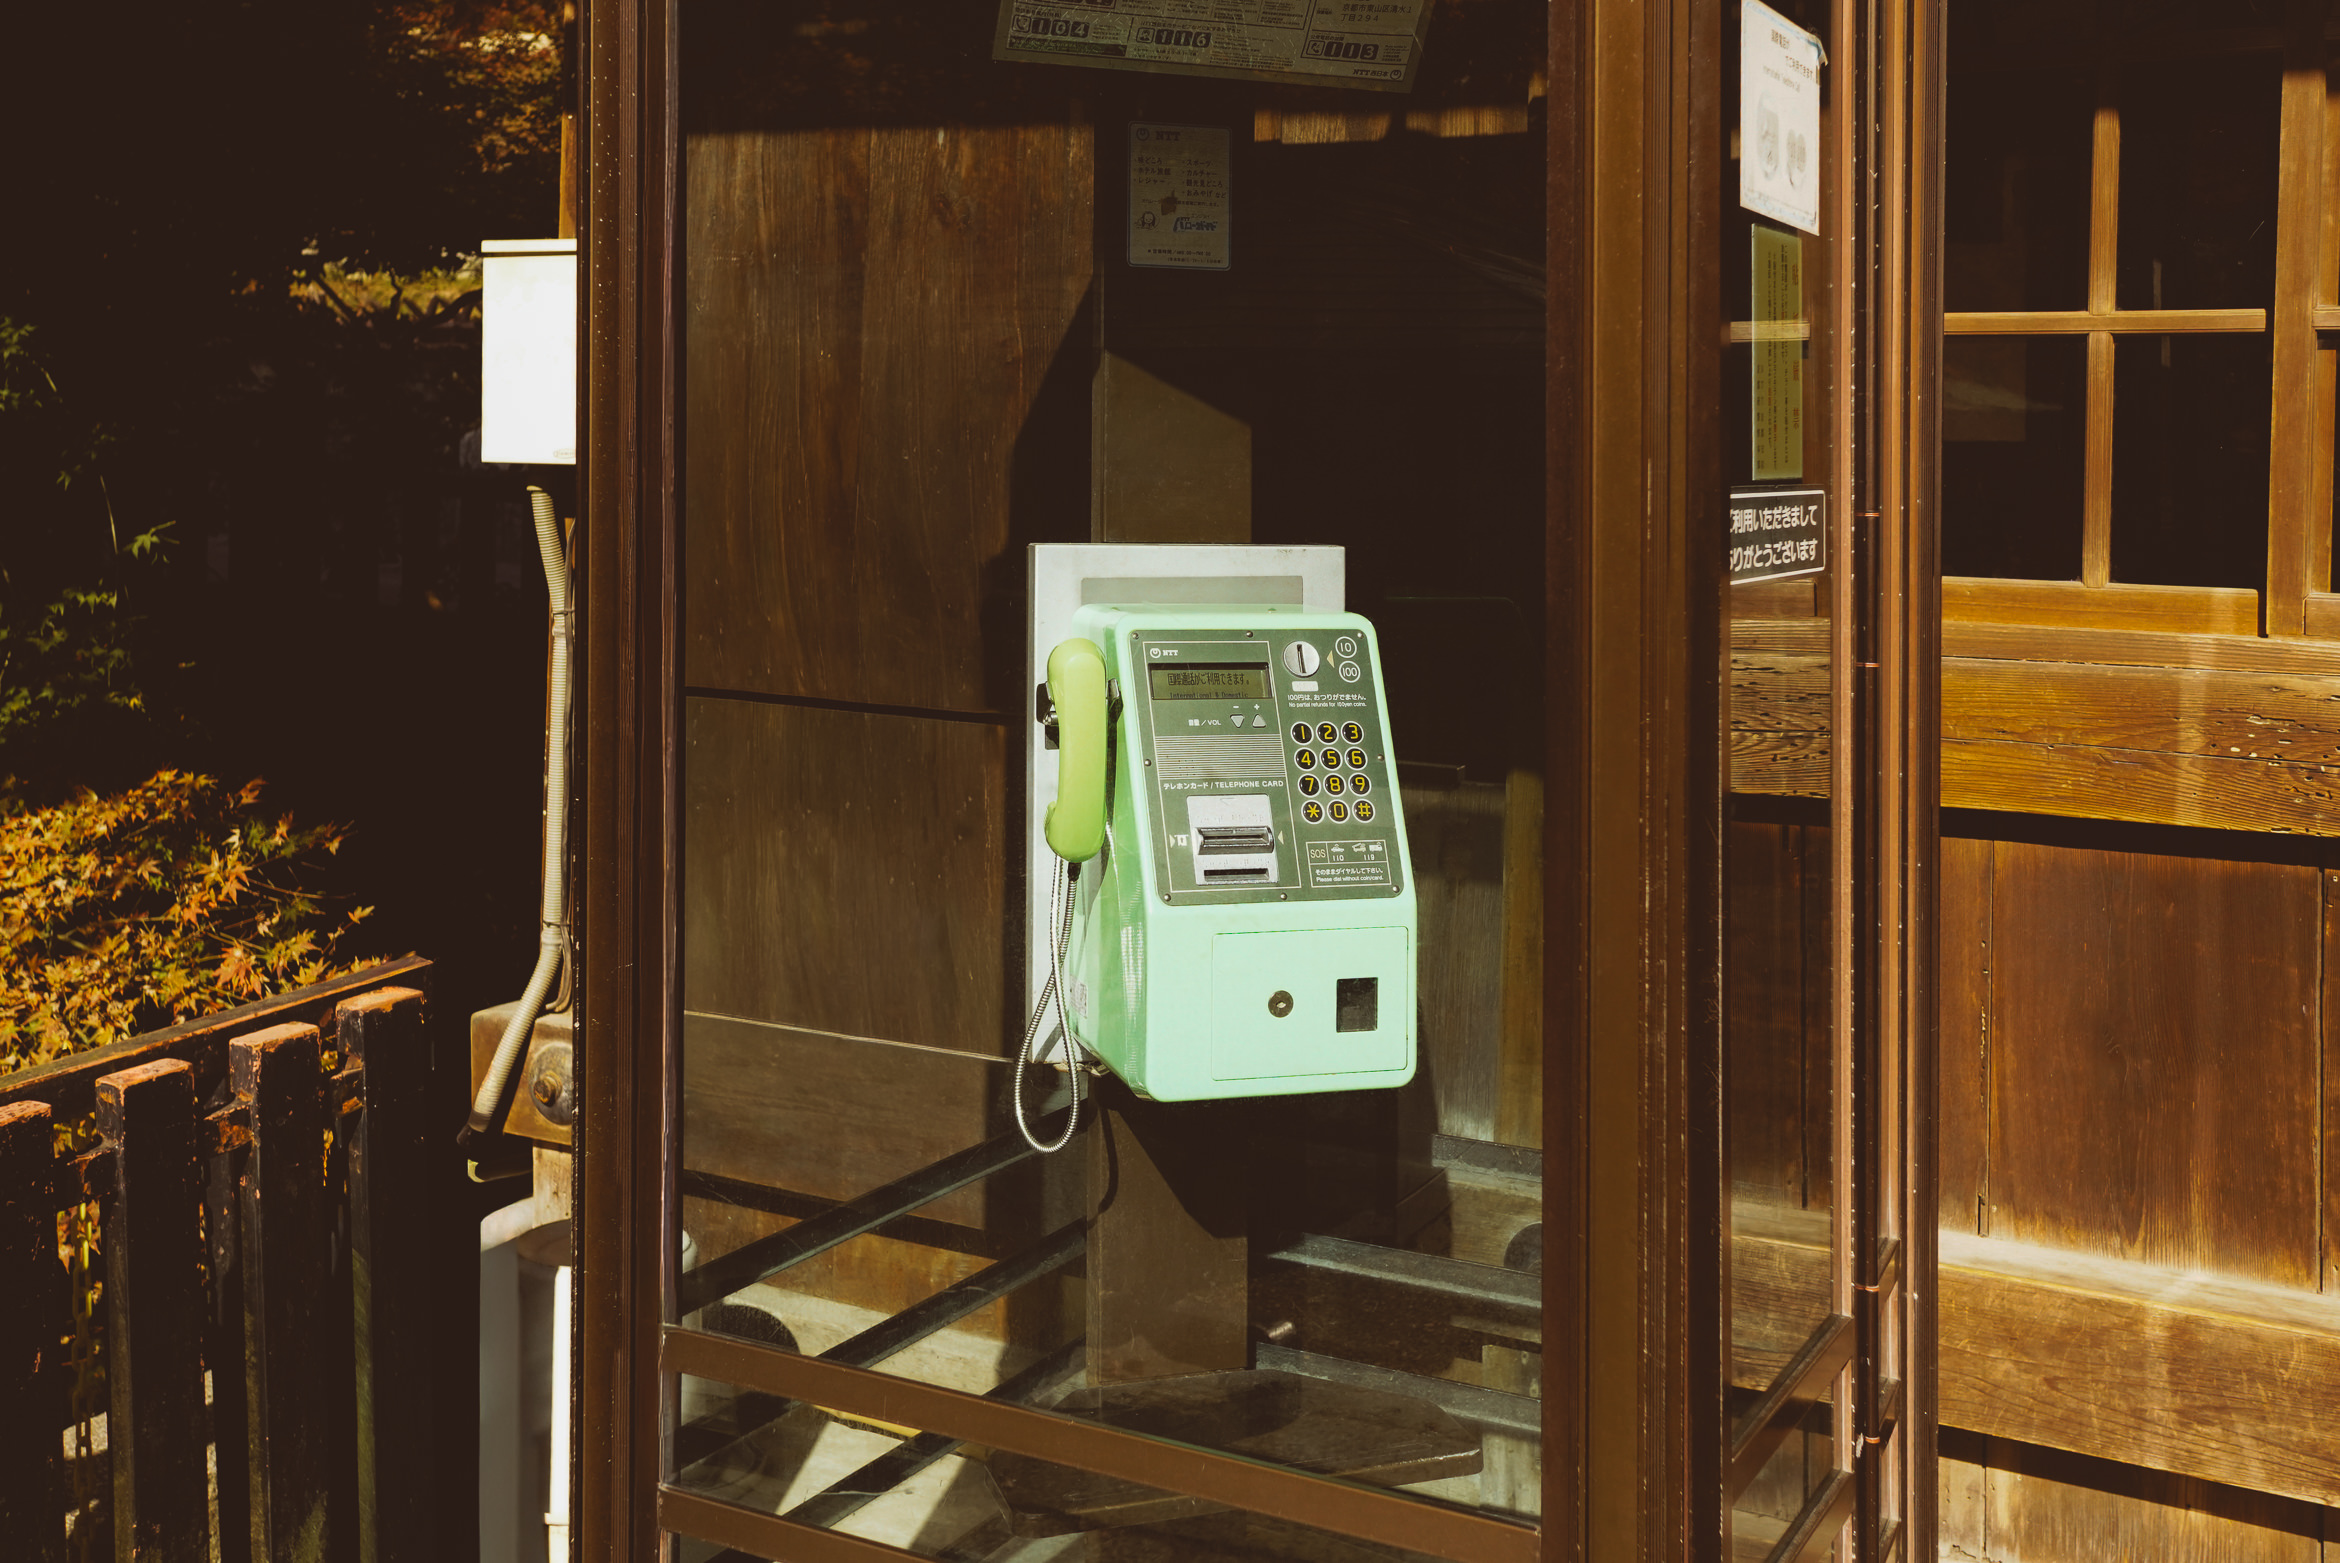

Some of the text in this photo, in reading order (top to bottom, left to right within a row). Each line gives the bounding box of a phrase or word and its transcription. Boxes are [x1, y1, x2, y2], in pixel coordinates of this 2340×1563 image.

[1036, 18, 1086, 37] 104
[1161, 30, 1208, 47] 116
[1329, 43, 1376, 59] 113
[1155, 131, 1181, 141] NTT
[1340, 642, 1352, 652] 10
[1342, 667, 1358, 677] 100
[1323, 725, 1333, 740] 2
[1348, 724, 1359, 739] 3
[1301, 750, 1362, 766] 4 5 6
[1214, 780, 1260, 789] TELEPHONE
[1261, 780, 1284, 788] CARD
[1304, 777, 1365, 792] 7 8 9
[1333, 803, 1345, 818] 0
[1310, 849, 1326, 858] SOS
